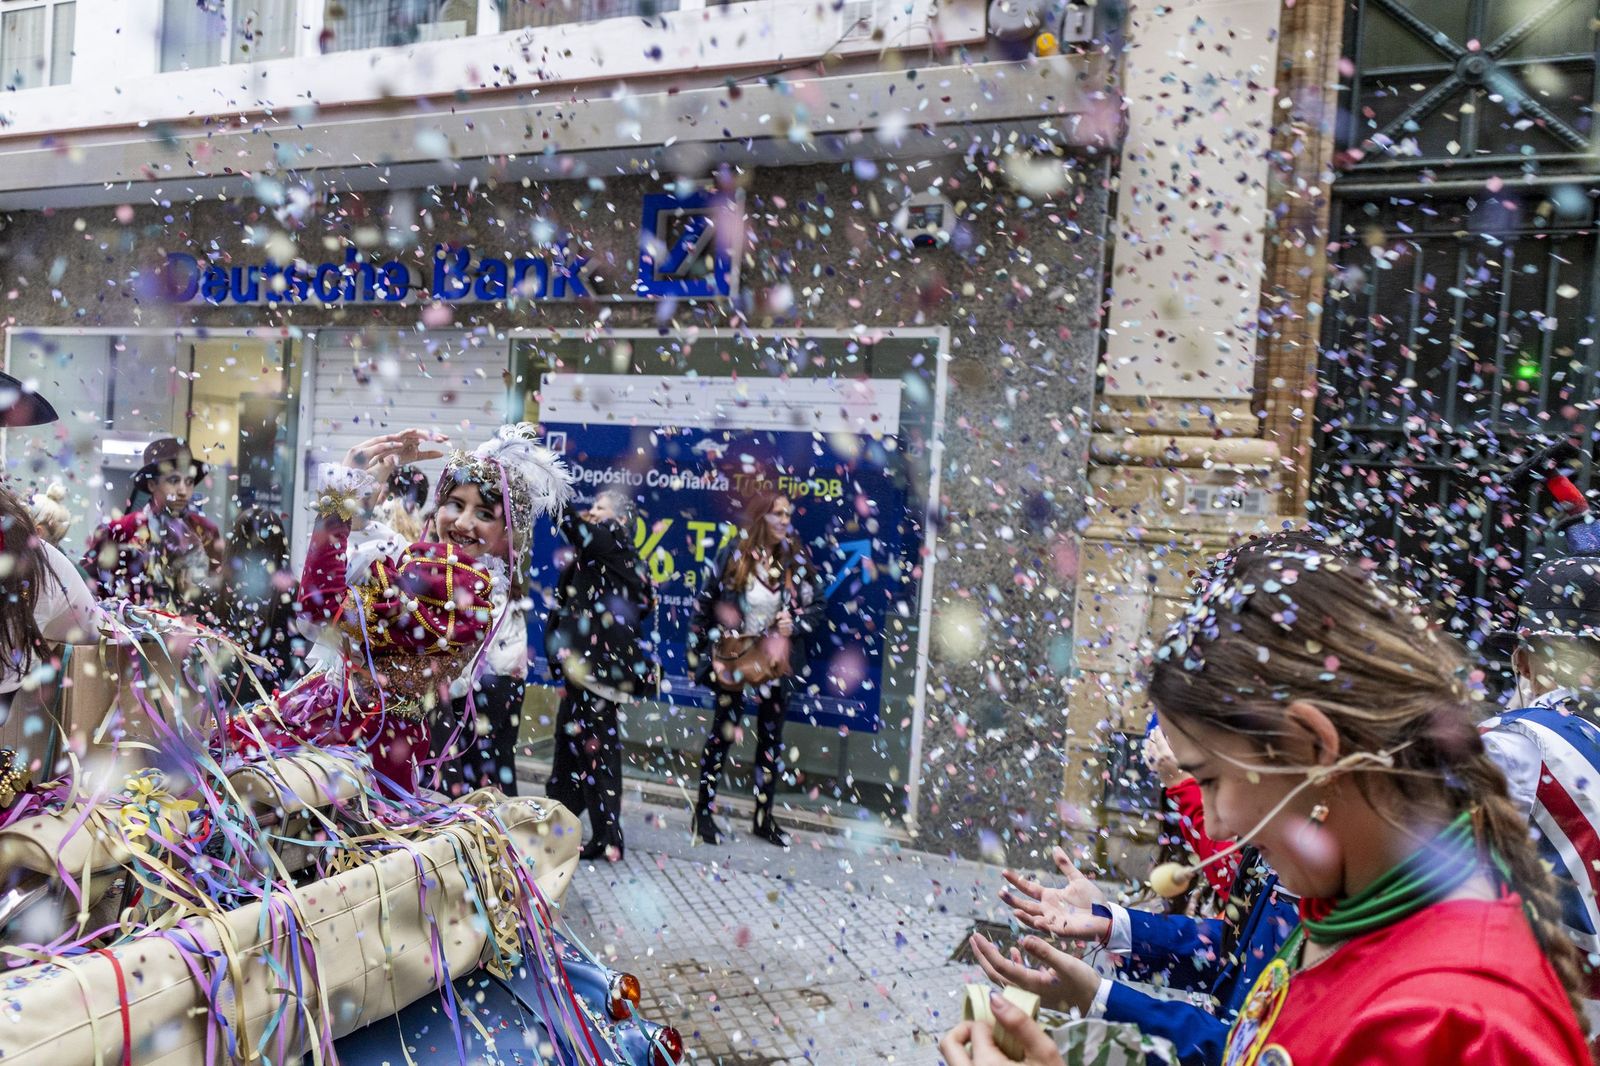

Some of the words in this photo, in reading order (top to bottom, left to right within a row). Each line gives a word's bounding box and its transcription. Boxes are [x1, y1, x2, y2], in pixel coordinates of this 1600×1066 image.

[166, 246, 410, 304] Deutsche
[432, 238, 590, 300] Bank
[572, 465, 643, 487] Depósito
[646, 469, 729, 492] Confianza
[778, 476, 810, 500] Fijo
[814, 478, 842, 498] DB
